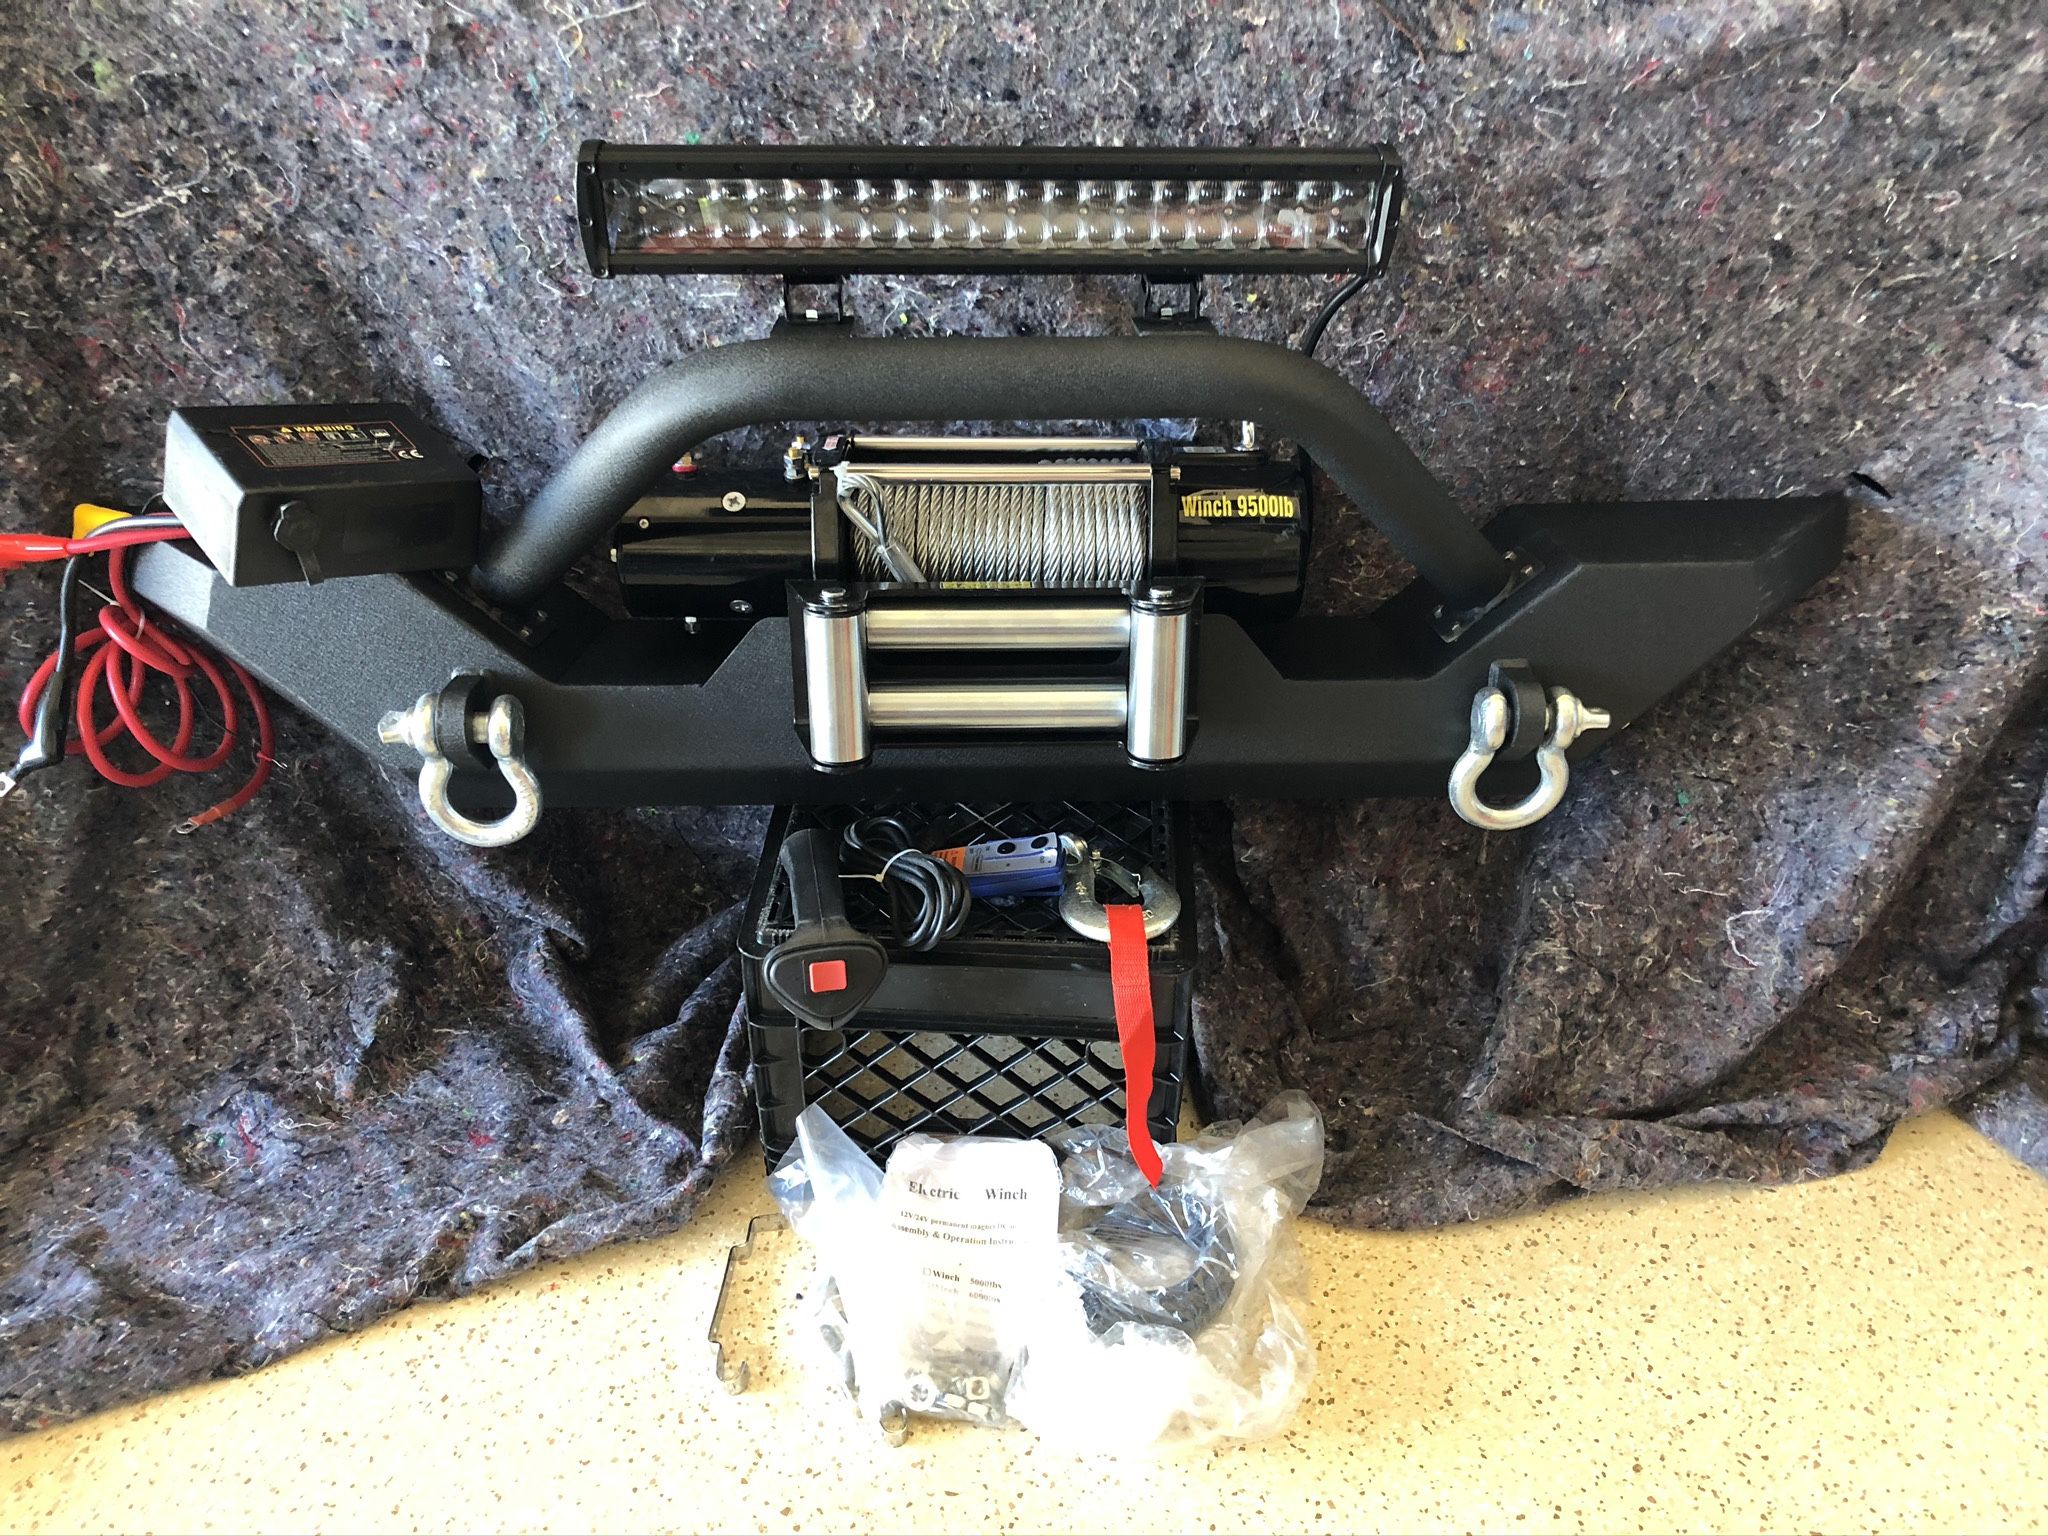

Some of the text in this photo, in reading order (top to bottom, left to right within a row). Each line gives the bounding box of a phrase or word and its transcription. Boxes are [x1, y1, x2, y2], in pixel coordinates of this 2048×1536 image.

[292, 424, 355, 433] WARNING
[1181, 495, 1294, 518] Winch 9500lb
[985, 1187, 1028, 1200] Winch
[900, 1209, 929, 1222] 12V/24V
[930, 1217, 969, 1229] permanent
[932, 1230, 940, 1239] &
[942, 1232, 987, 1246] Operation
[932, 1269, 960, 1283] Winch
